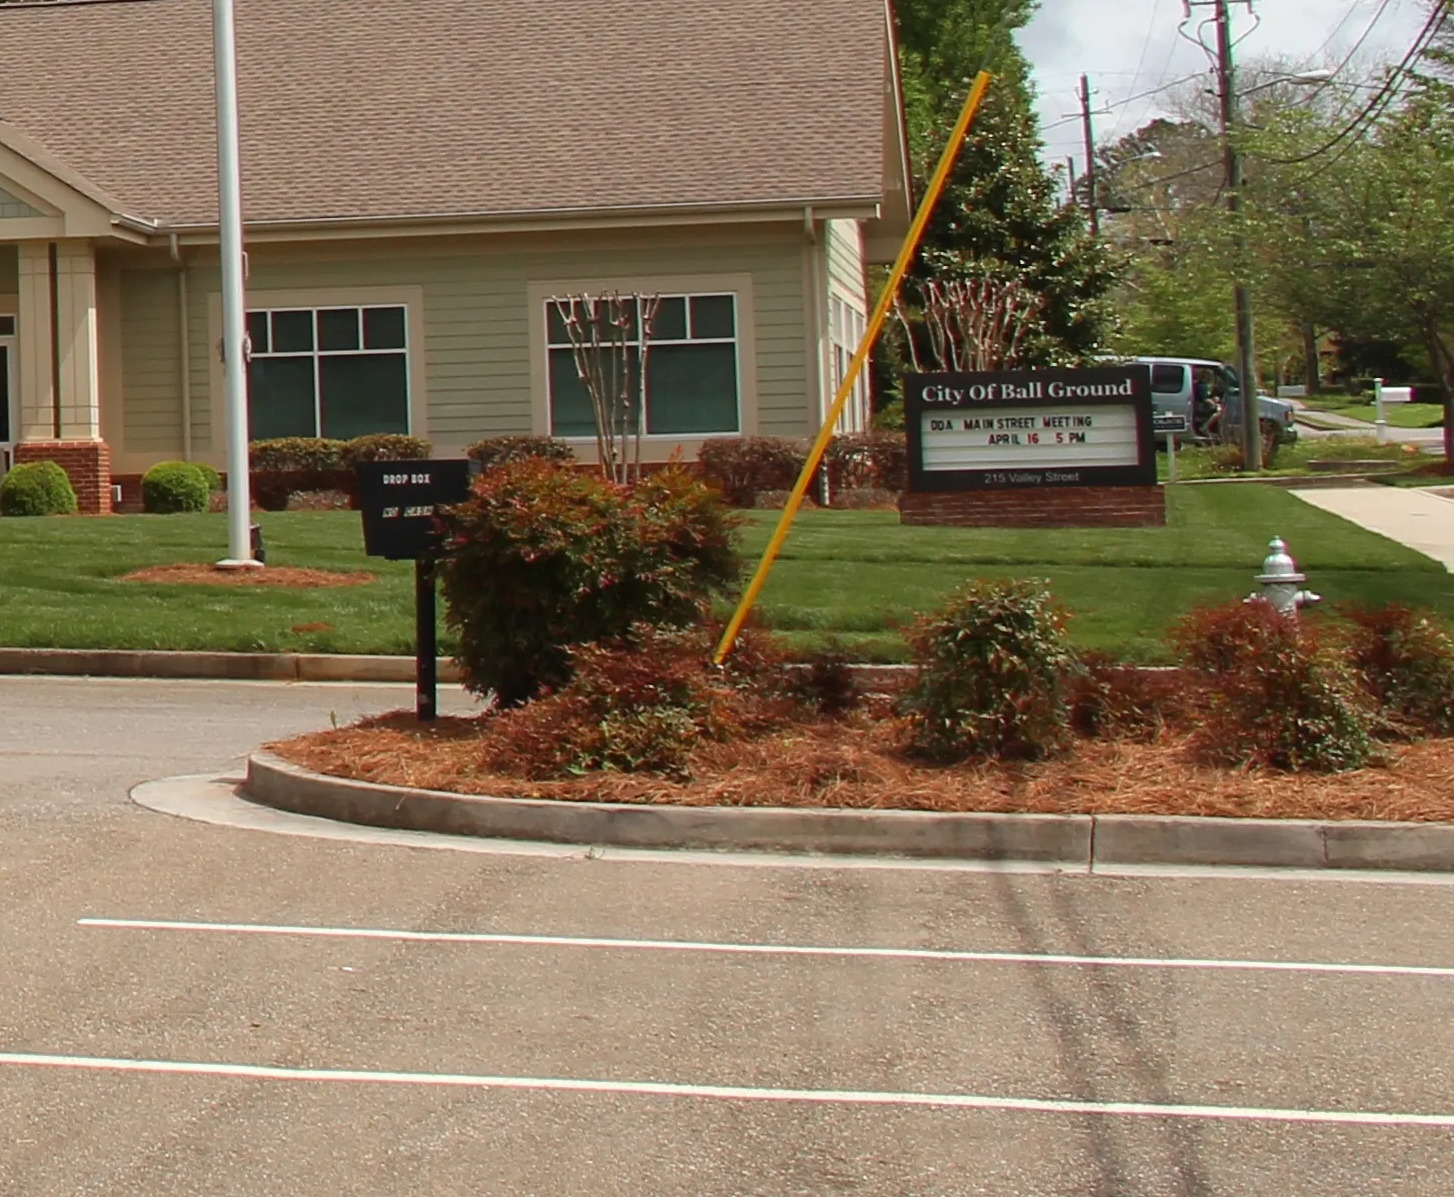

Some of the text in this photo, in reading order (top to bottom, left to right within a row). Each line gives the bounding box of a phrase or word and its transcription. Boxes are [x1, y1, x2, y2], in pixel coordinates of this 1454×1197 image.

[922, 378, 1133, 405] City Of Ball Ground
[963, 418, 994, 430] MAIN
[997, 417, 1035, 429] STREET
[1042, 416, 1092, 427] MEETING
[988, 432, 1085, 445] APRIL 16 5 PM
[383, 473, 431, 484] DROP BOX
[984, 470, 1080, 485] 215 Valley Street
